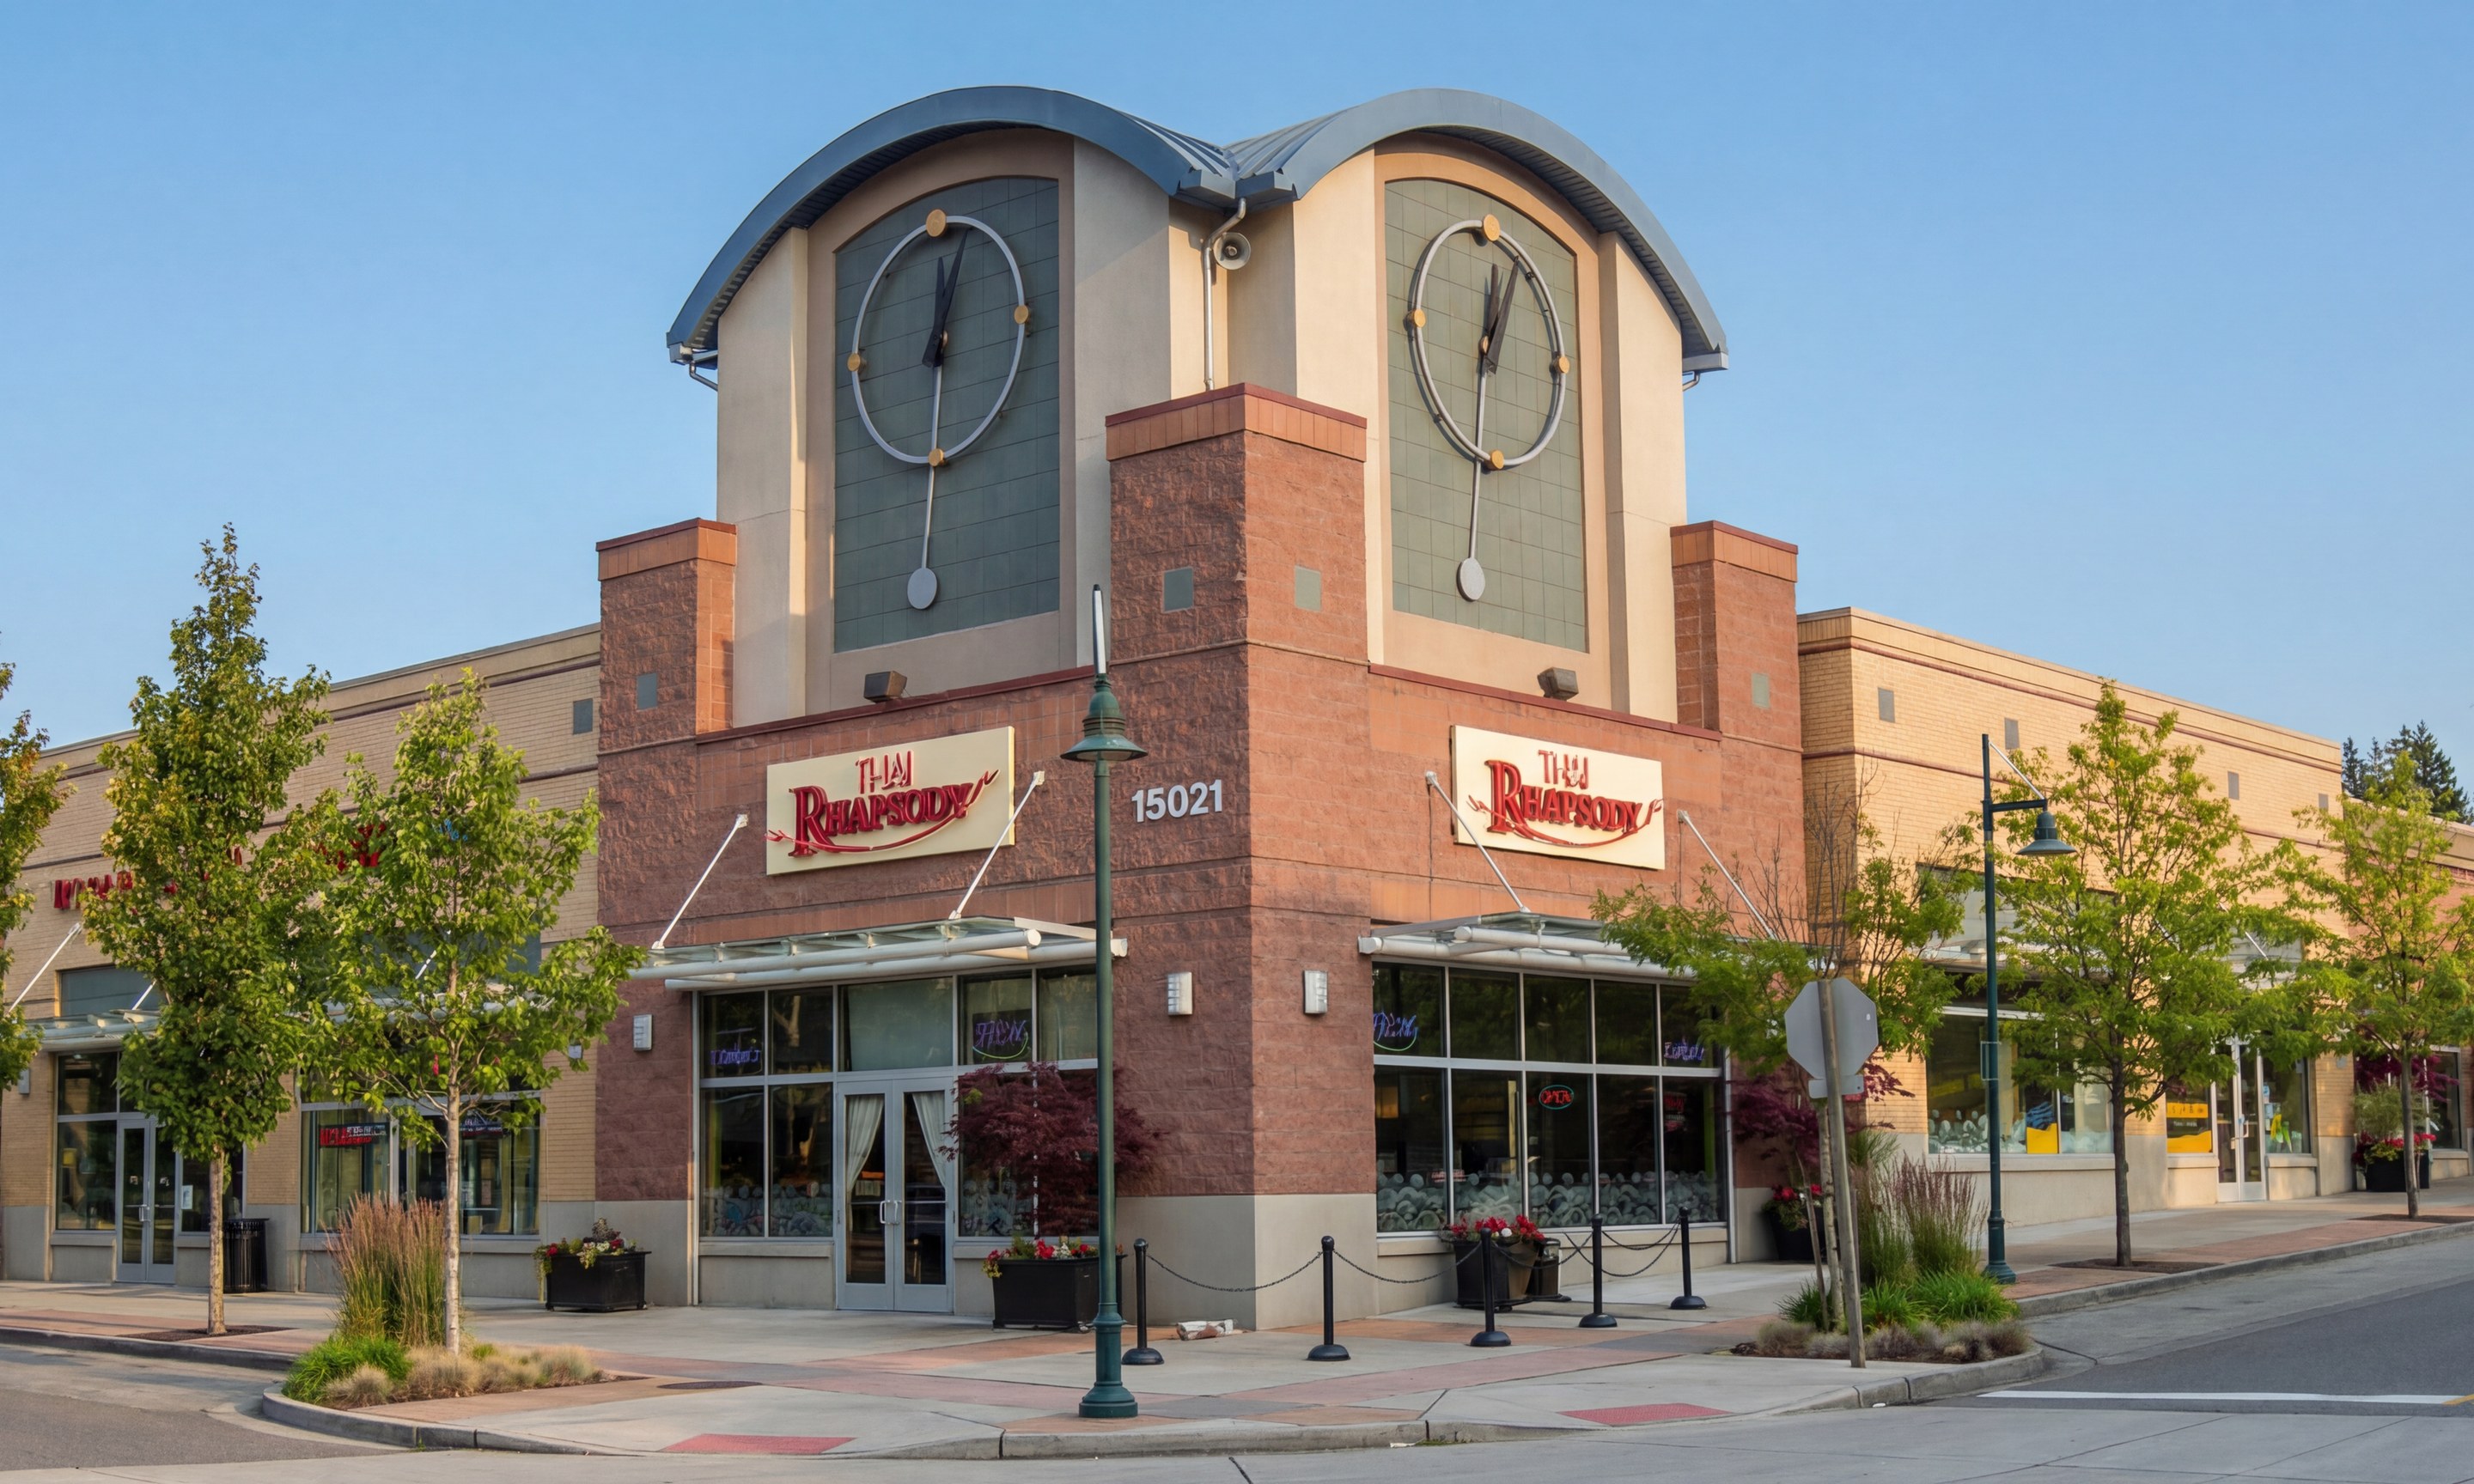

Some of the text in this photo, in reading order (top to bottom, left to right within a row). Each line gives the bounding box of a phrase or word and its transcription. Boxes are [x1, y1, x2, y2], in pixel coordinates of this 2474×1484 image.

[855, 750, 914, 794] THAI
[1131, 779, 1222, 823] 15021
[1484, 759, 1643, 836] RHAPSODY
[788, 782, 976, 858] RHAPSODY
